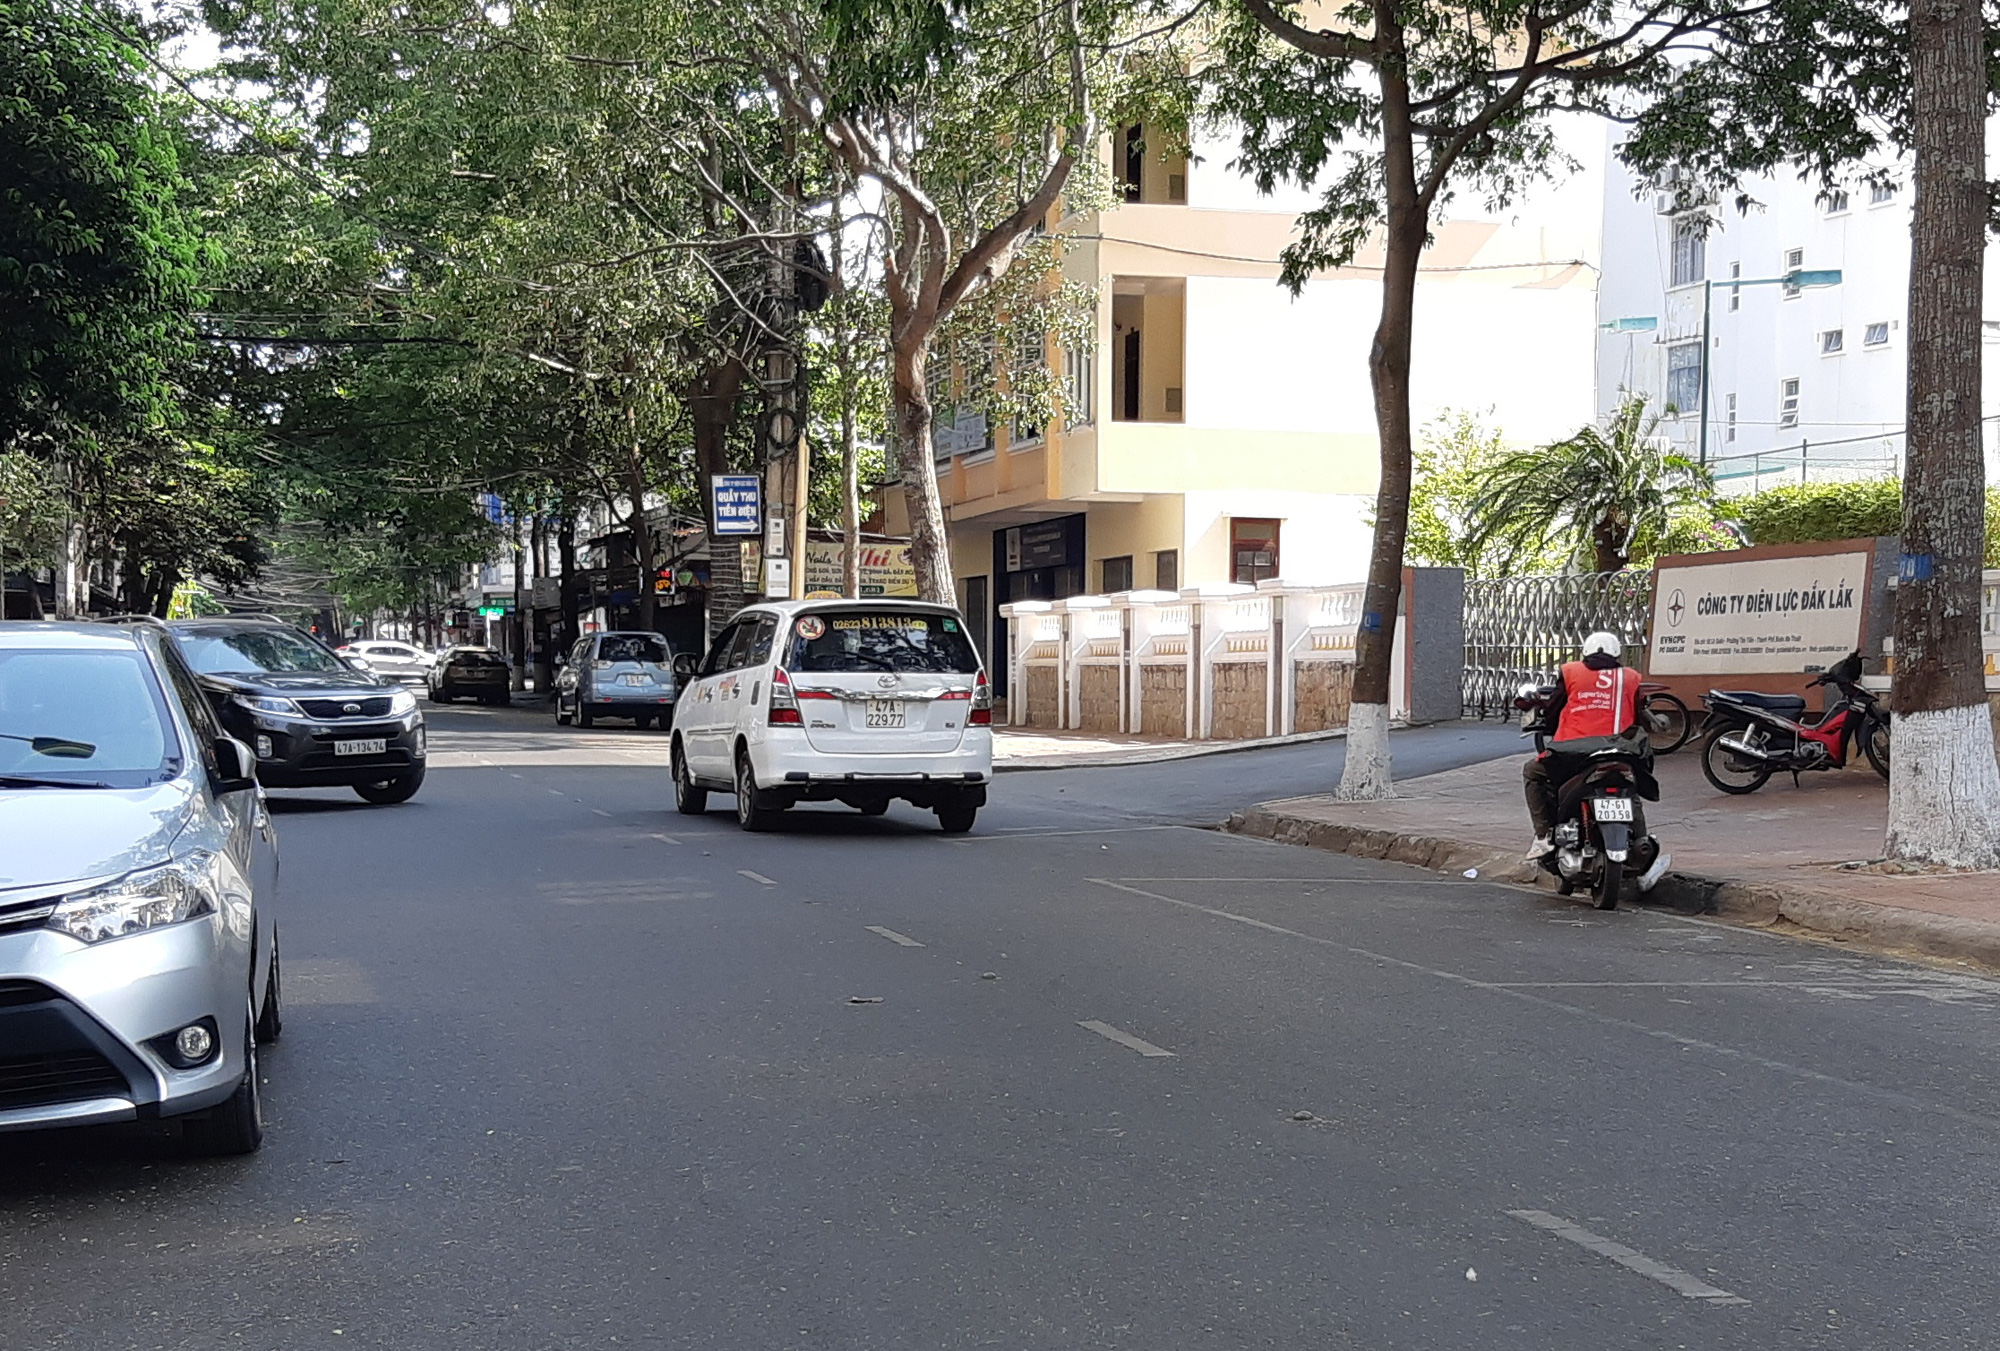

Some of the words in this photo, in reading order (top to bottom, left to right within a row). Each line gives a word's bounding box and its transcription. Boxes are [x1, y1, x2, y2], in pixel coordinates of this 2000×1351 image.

[740, 492, 756, 502] THU
[1697, 592, 1727, 616] CÔNG
[1730, 595, 1745, 614] TY
[1746, 588, 1772, 618] ĐIỆN
[1775, 588, 1799, 617] LỰC
[1801, 580, 1826, 611] ĐẮK
[1829, 578, 1854, 610] LẮK
[875, 699, 896, 713] 47A
